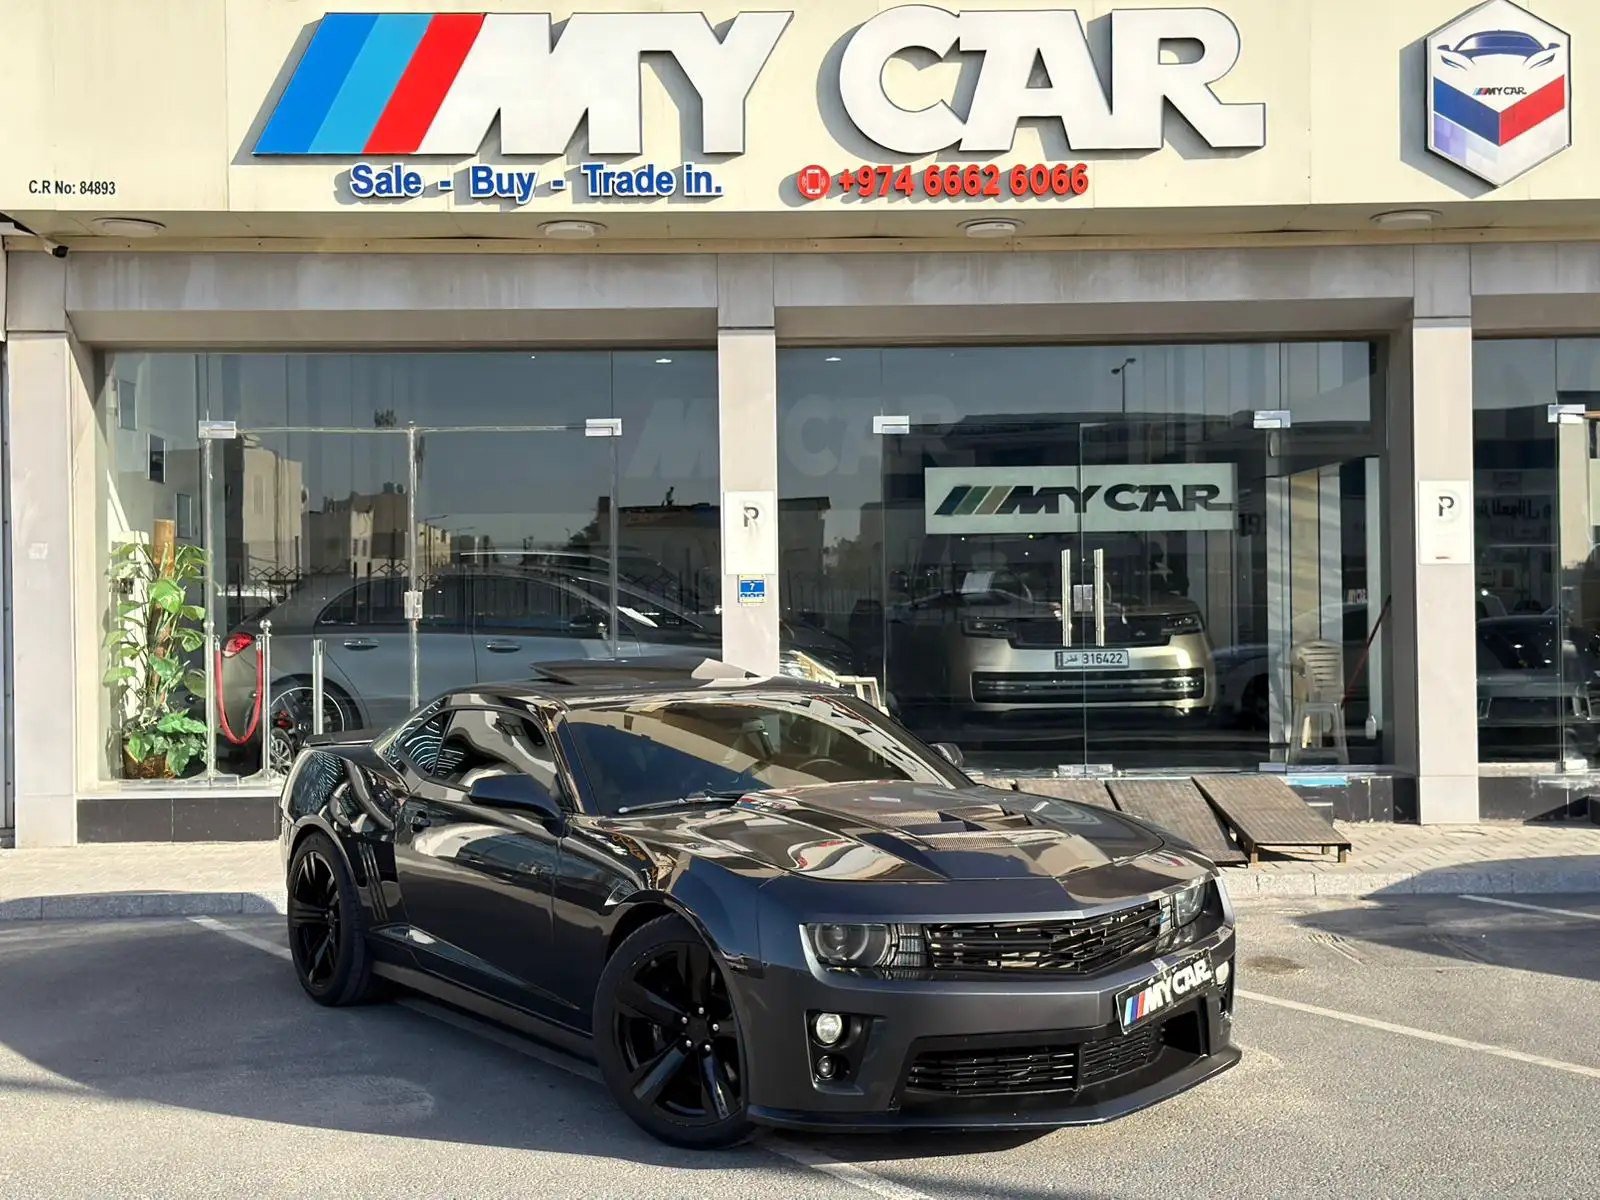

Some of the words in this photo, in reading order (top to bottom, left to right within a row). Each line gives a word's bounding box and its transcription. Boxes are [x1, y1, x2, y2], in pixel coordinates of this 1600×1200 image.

[416, 12, 793, 155] MY
[839, 5, 1266, 154] CAR
[1503, 86, 1528, 96] CAR
[28, 179, 51, 194] C.R
[54, 180, 76, 194] No:
[79, 180, 116, 195] 84893
[350, 163, 424, 197] Sale
[470, 164, 536, 204] Buy
[581, 162, 676, 197] Trade
[683, 162, 724, 197] in.
[838, 164, 914, 198] +974
[922, 164, 1001, 197] 6662
[1009, 162, 1090, 196] 6066
[994, 485, 1103, 514] MY
[1103, 483, 1233, 513] CAR
[1082, 652, 1123, 665] 316422
[1143, 974, 1174, 1017] MY
[1172, 959, 1212, 995] CAR
